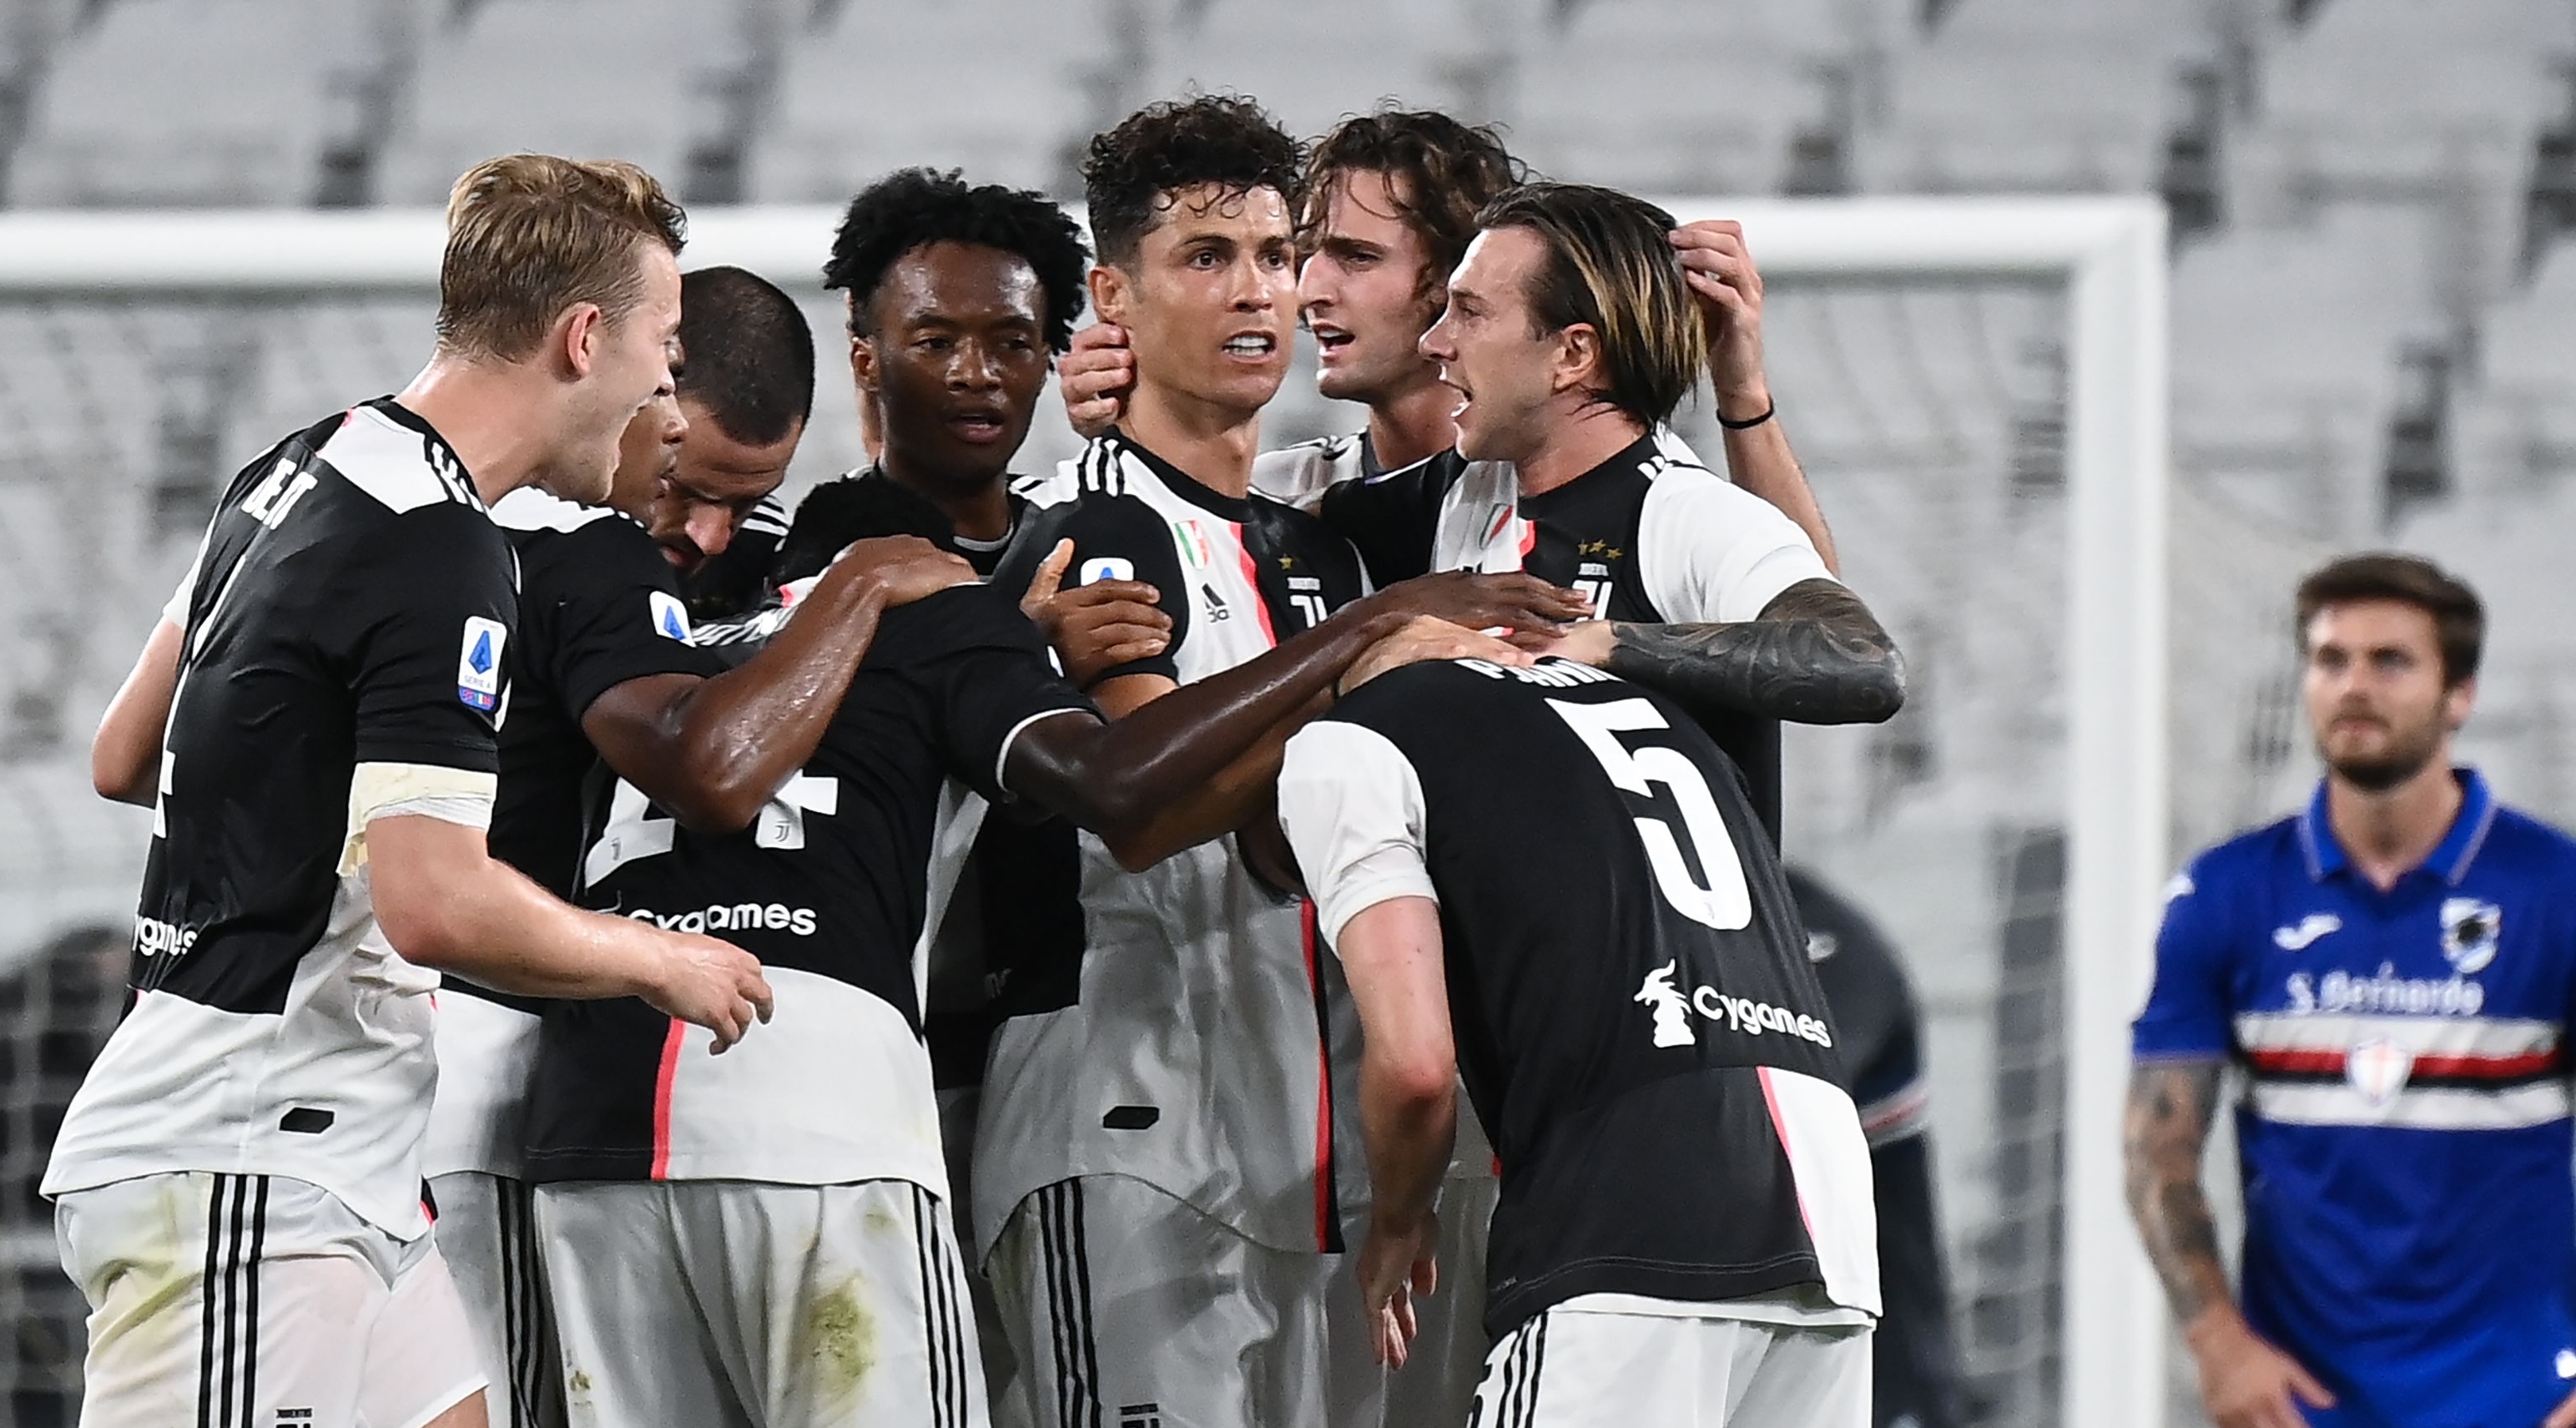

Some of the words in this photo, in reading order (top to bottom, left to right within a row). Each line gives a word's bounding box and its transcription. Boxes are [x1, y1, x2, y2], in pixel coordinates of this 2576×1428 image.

[1454, 658, 1626, 688] PJANI
[1544, 697, 1752, 931] 5
[1693, 985, 1832, 1048] Cygames
